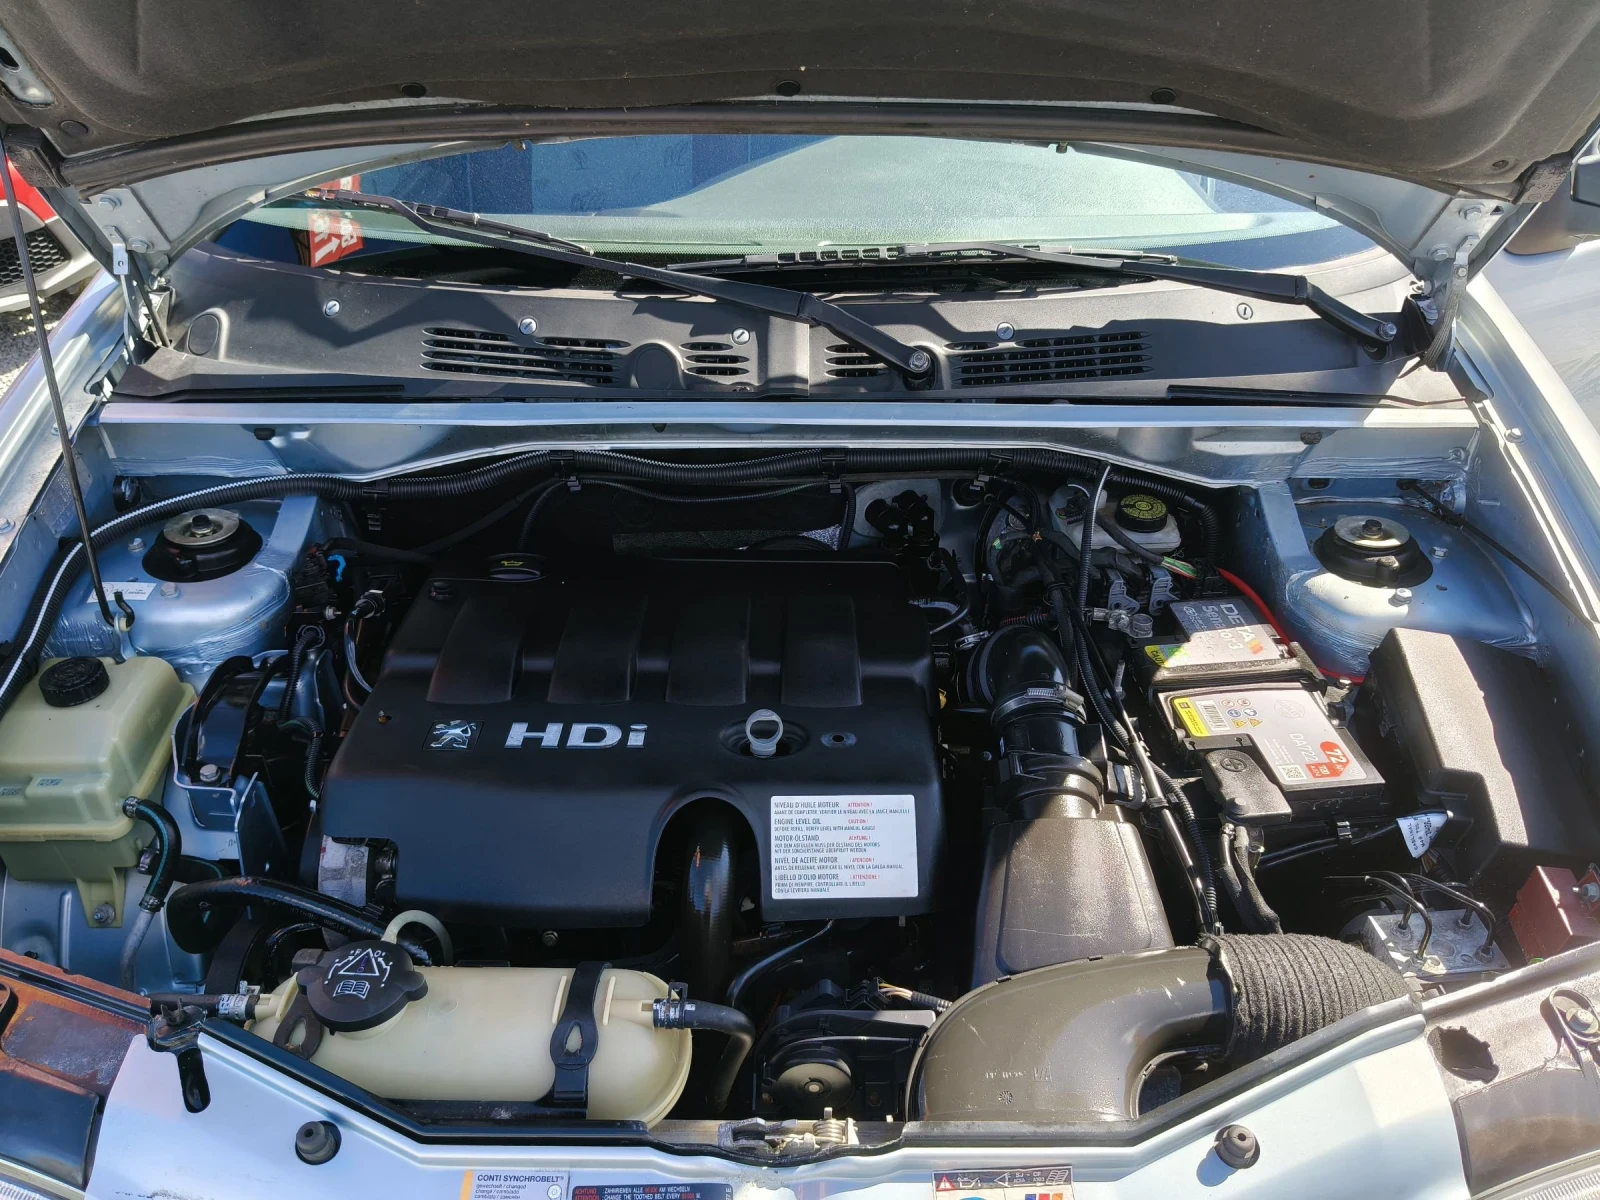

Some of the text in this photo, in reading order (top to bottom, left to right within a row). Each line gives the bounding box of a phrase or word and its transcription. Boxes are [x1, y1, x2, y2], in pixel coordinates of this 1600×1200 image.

[1220, 603, 1256, 643] DETA
[504, 721, 648, 749] HDi
[1289, 733, 1319, 762] DA722
[1325, 748, 1347, 764] 72
[477, 1174, 502, 1182] CONTI
